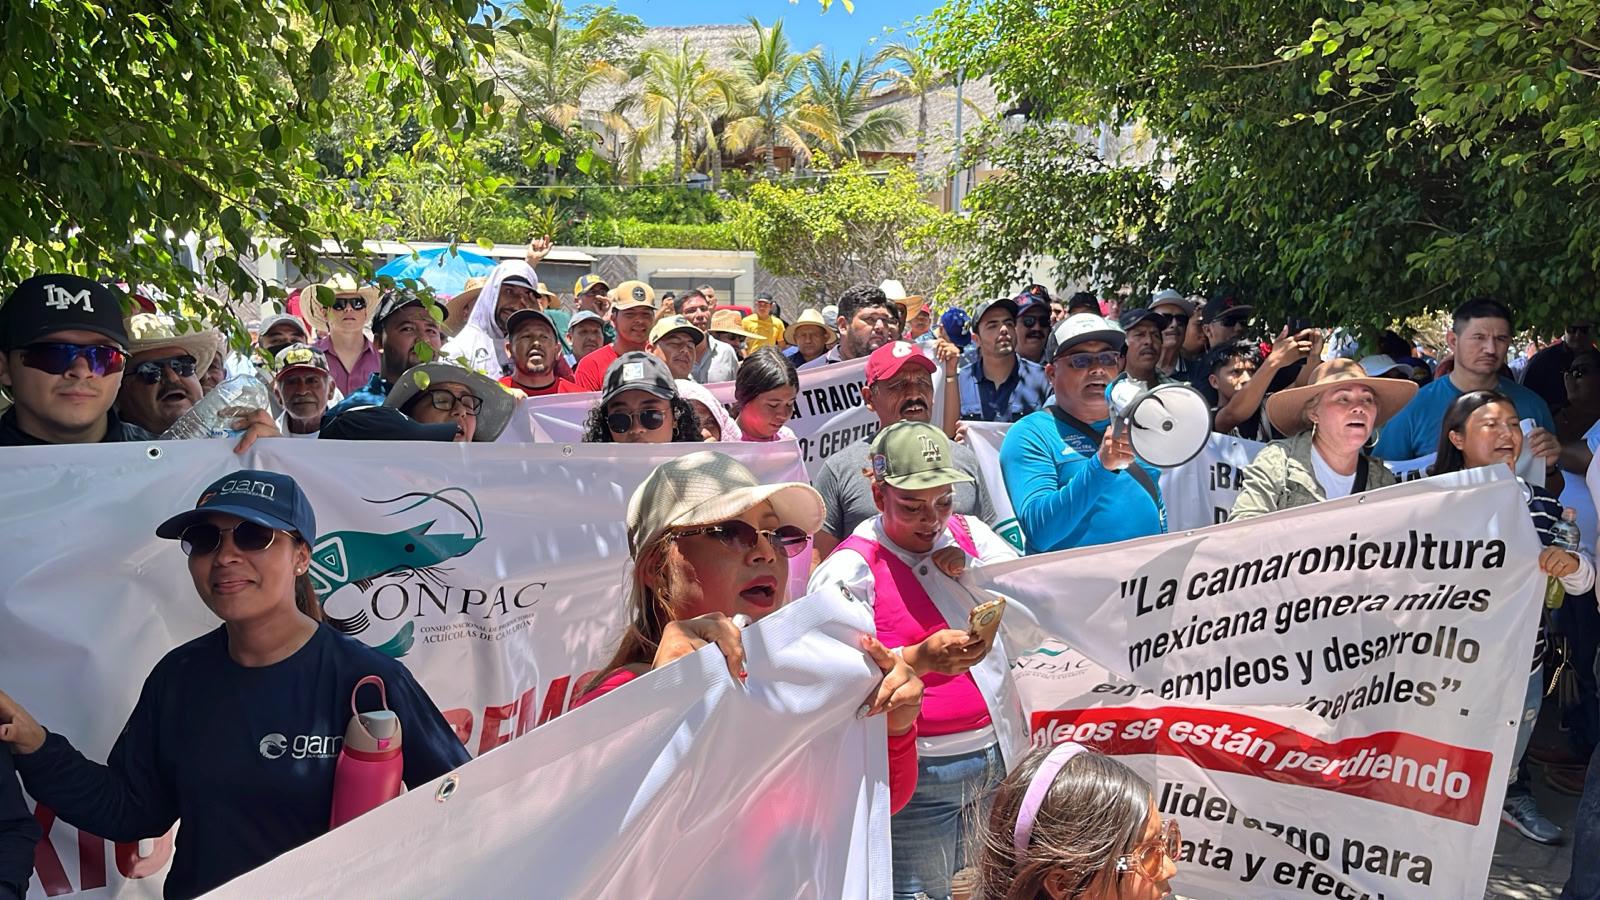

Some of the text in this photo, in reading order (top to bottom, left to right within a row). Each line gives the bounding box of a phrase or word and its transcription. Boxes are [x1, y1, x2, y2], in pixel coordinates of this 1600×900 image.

[43, 283, 94, 313] LM
[917, 434, 941, 462] LA
[220, 479, 275, 499] gam
[1120, 575, 1178, 617] "La
[1186, 529, 1506, 601] camaronicultura
[322, 580, 547, 636] CONPAC
[420, 624, 451, 634] CONSEJO
[453, 621, 487, 633] NACIONAL
[422, 629, 477, 644] ACUÍCOLAS
[480, 631, 494, 642] DE
[1128, 584, 1492, 673] mexicana genera miles
[1160, 625, 1480, 700] empleos y desarrollo
[291, 734, 344, 759] gam
[1121, 717, 1164, 741] se
[1167, 719, 1276, 764] están
[1276, 747, 1470, 800] perdiendo
[1240, 852, 1266, 882] y
[1341, 837, 1433, 886] para
